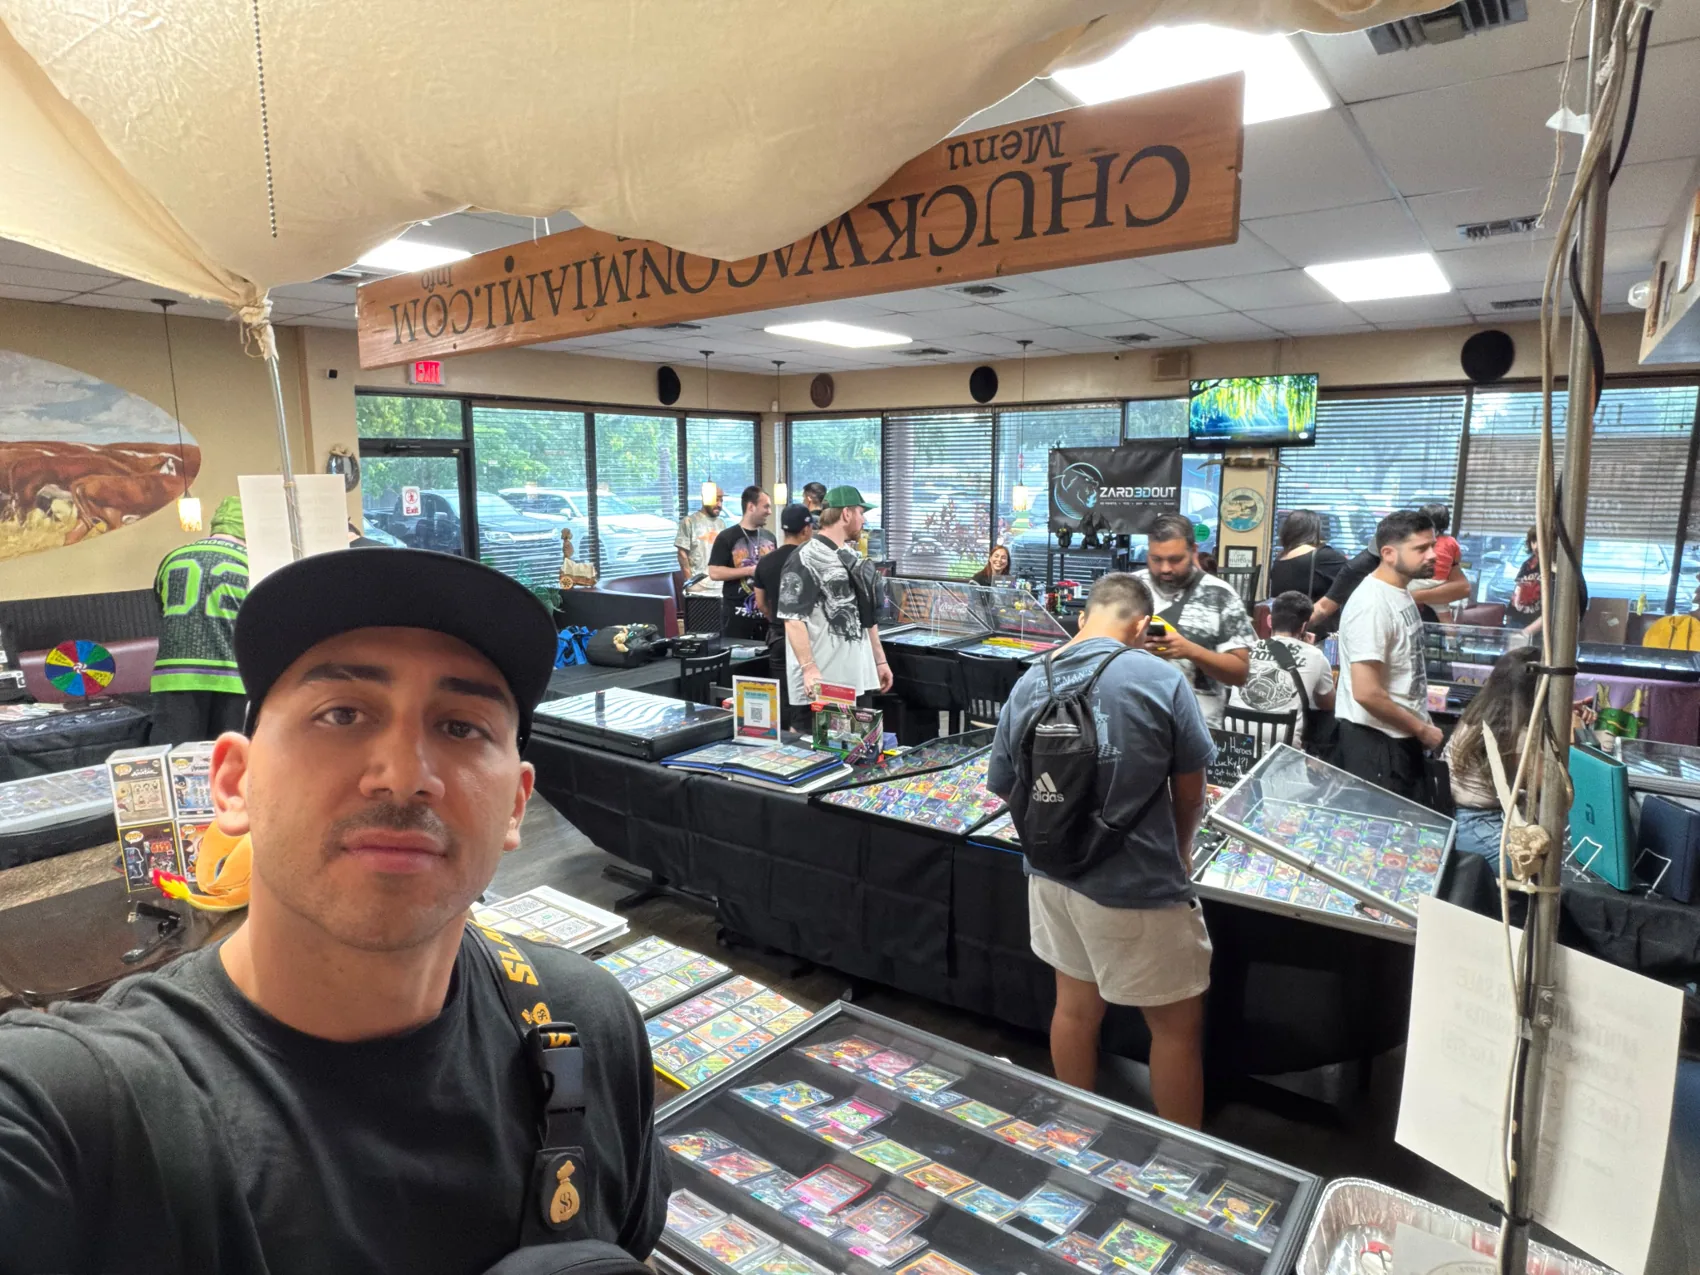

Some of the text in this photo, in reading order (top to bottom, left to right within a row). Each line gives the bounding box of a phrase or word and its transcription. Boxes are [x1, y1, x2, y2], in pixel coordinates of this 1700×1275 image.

[949, 120, 1065, 173] Menu
[421, 266, 453, 293] Info
[416, 362, 440, 383] EXIT
[1099, 486, 1177, 499] ZARD3DOUT
[405, 506, 419, 515] Exit
[161, 558, 249, 619] 02
[1039, 669, 1094, 688] MRMAN'S
[1229, 736, 1252, 756] Heroes
[1032, 790, 1065, 803] didas
